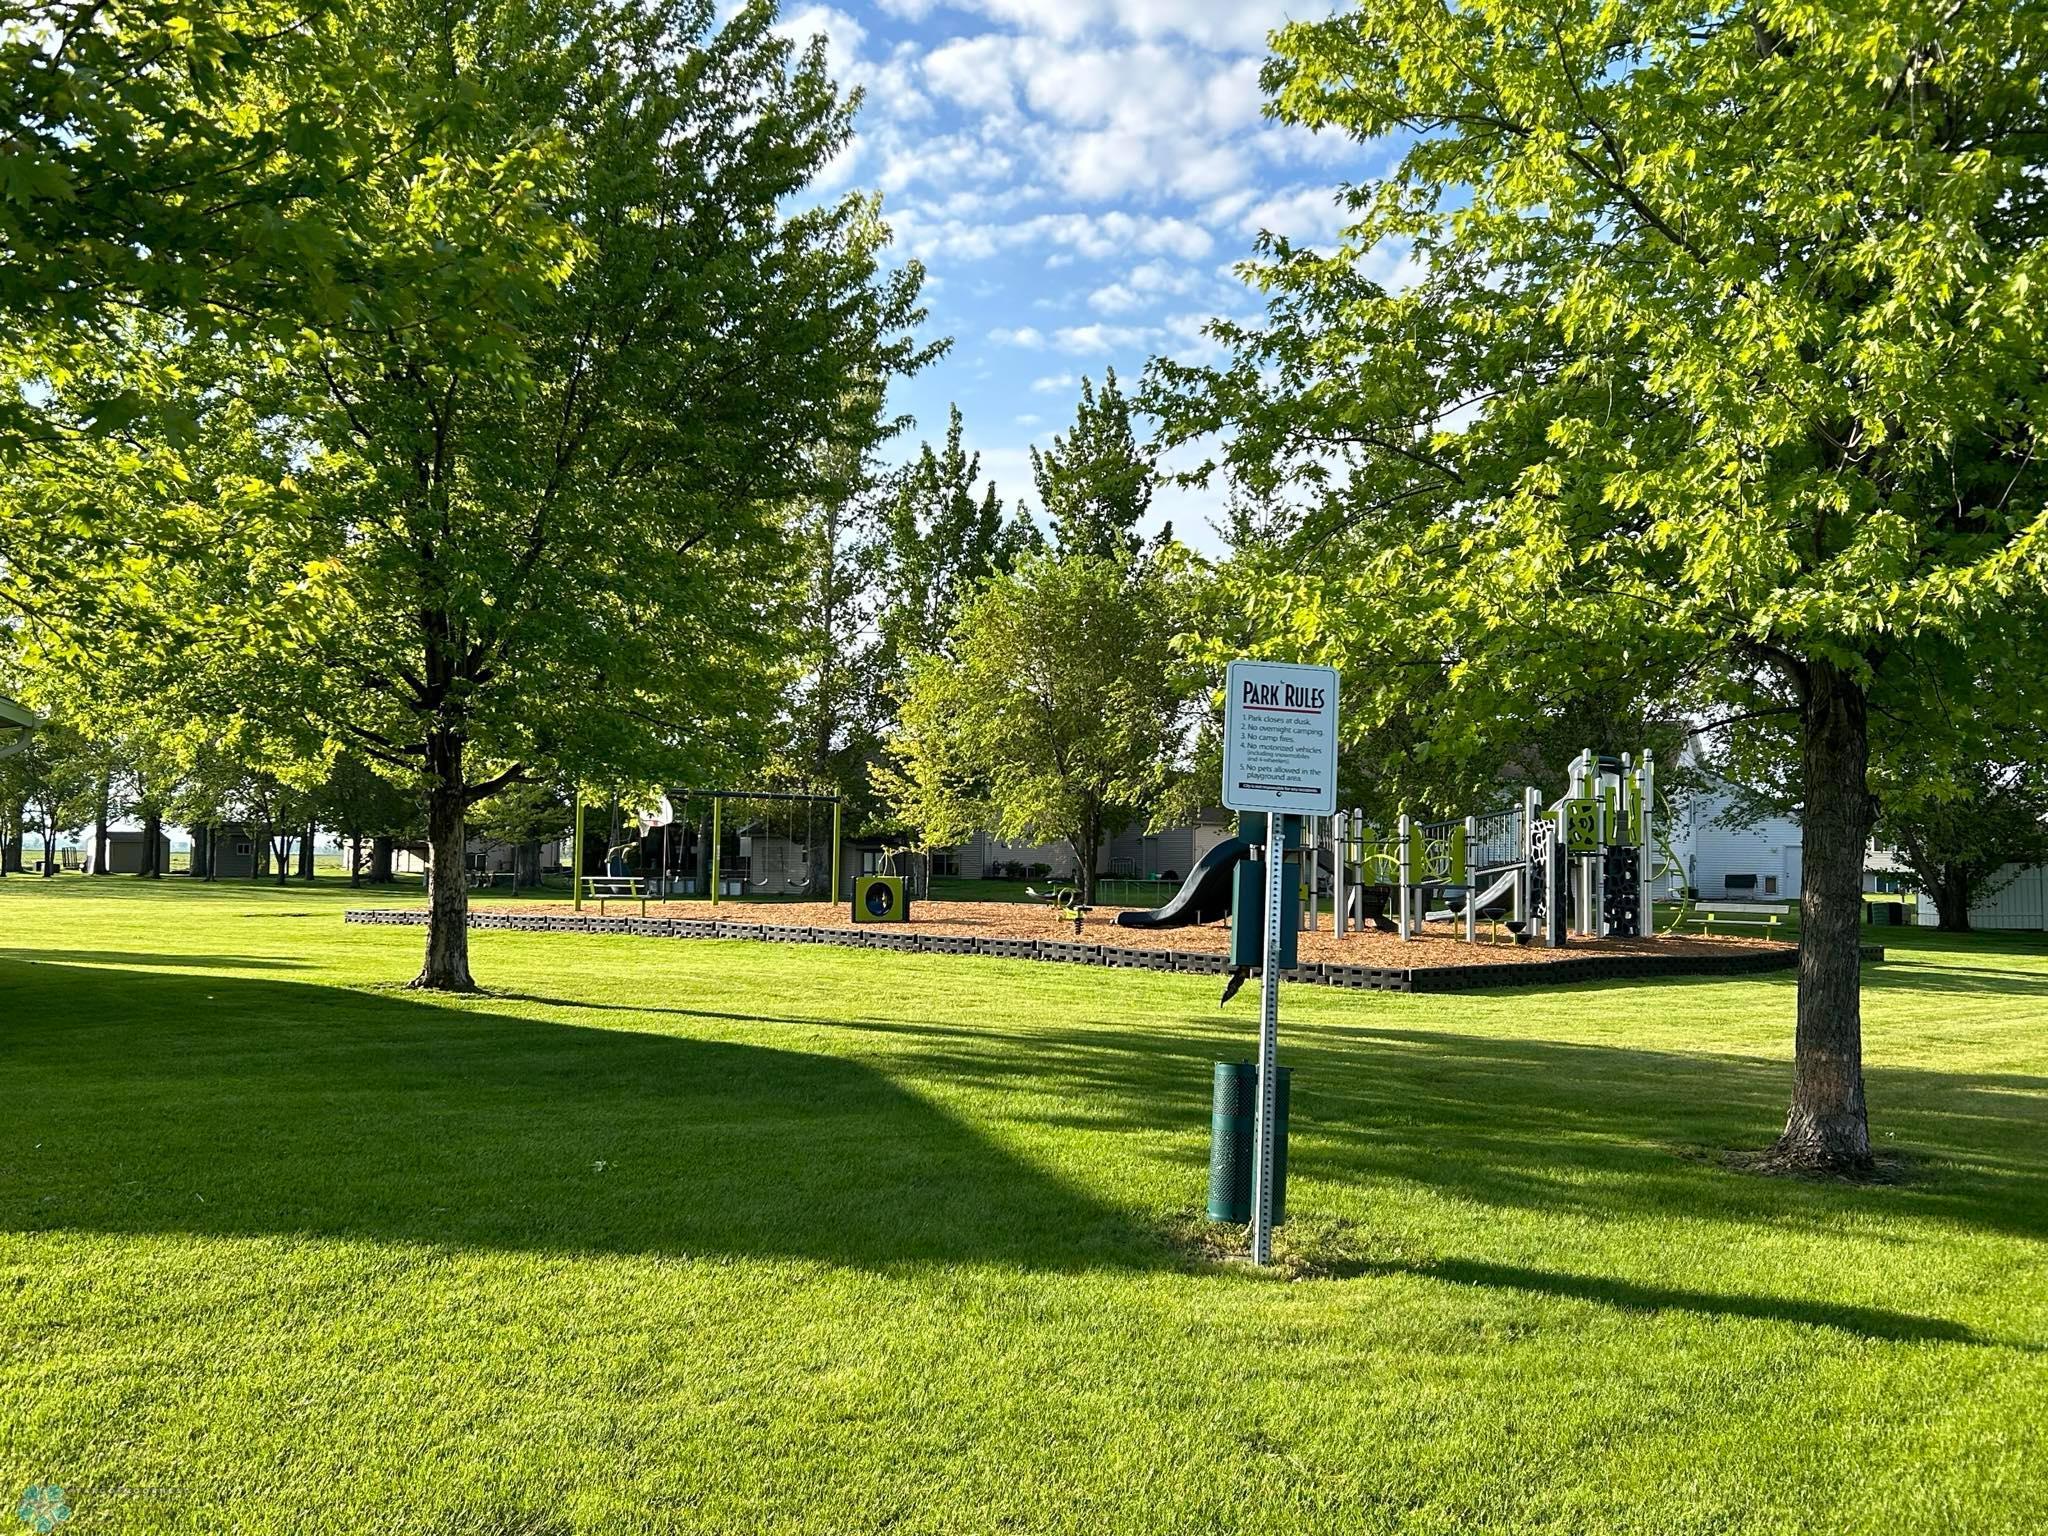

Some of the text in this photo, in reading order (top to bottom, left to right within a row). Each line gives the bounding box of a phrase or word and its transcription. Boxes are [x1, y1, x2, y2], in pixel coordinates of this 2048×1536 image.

[1243, 681, 1325, 709] PARK RULES
[1248, 714, 1262, 722] Park
[1264, 716, 1284, 724] closes
[1259, 725, 1292, 735] overnight
[1247, 742, 1257, 750] No
[1259, 744, 1293, 752] motorized
[1295, 746, 1322, 754] vehicles
[1246, 763, 1256, 771] No
[1274, 766, 1300, 774] allowed
[1310, 768, 1321, 776] the
[1247, 772, 1285, 781] playground
